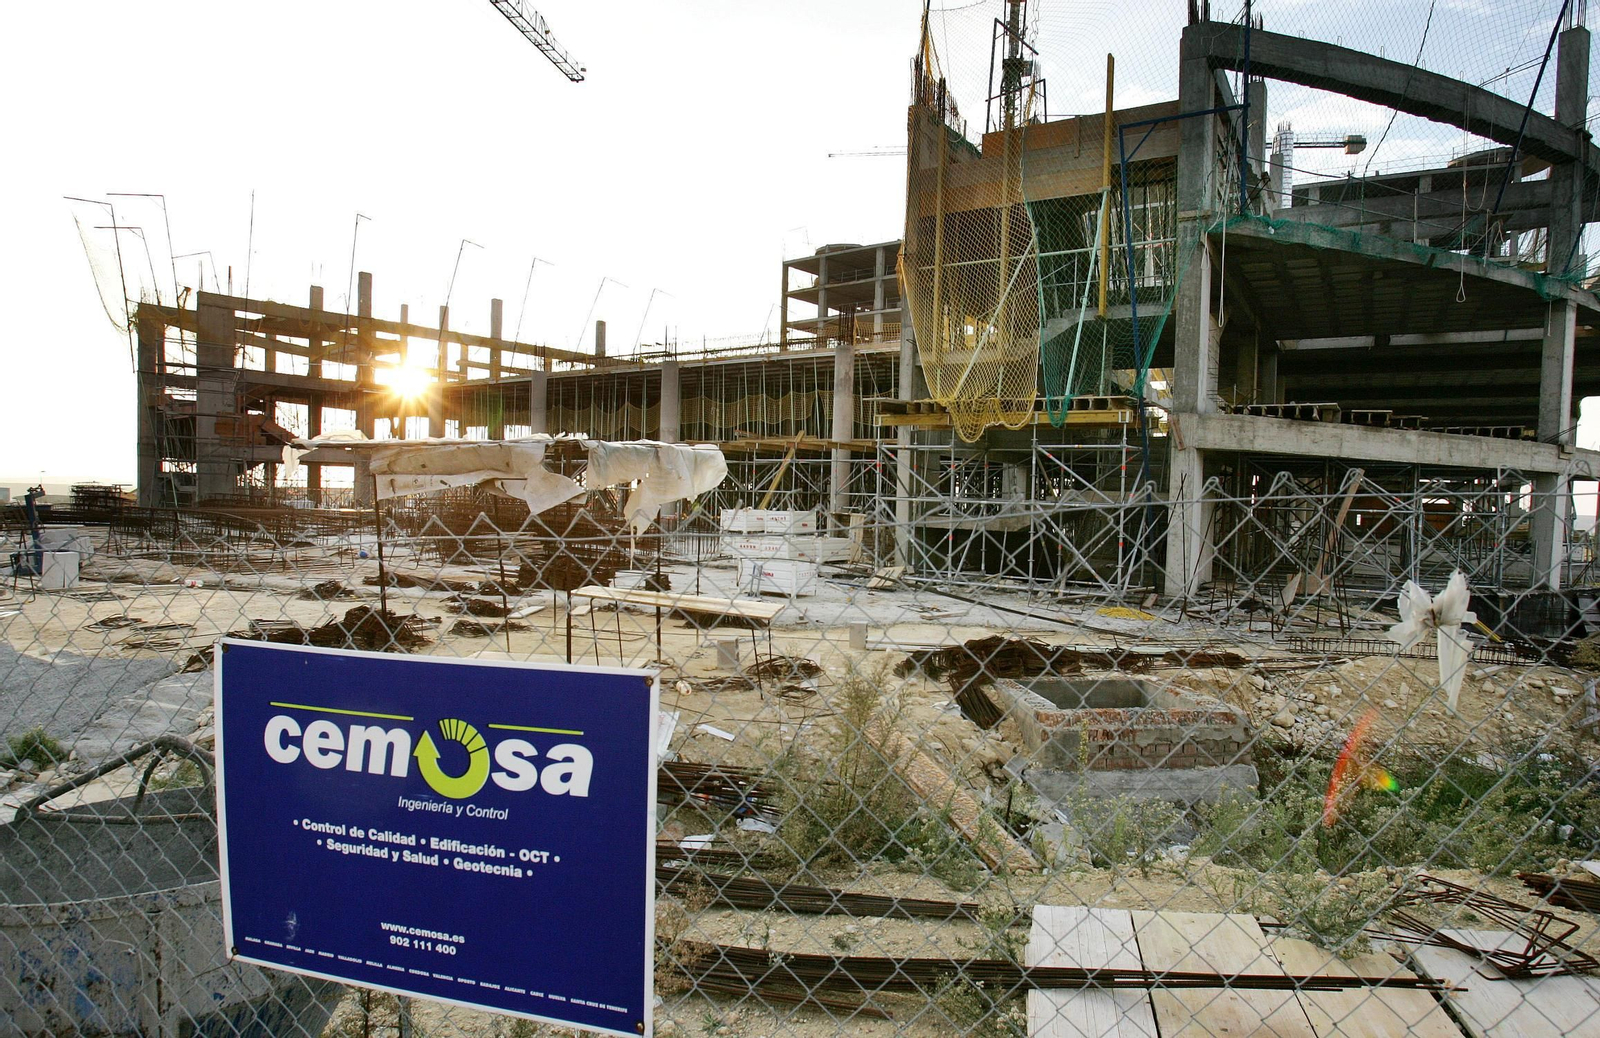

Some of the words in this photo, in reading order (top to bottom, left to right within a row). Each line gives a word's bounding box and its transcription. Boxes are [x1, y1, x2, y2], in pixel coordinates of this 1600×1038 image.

[263, 714, 594, 800] cemosa
[397, 796, 453, 814] Ingeniería
[456, 805, 464, 818] y
[466, 804, 509, 821] Control
[301, 818, 346, 836] Control
[349, 825, 365, 839] de
[367, 828, 416, 846] Calidad
[429, 836, 506, 859] Edificación
[518, 848, 550, 864] OCT
[326, 838, 389, 859] Seguridad
[391, 850, 400, 863] y
[402, 850, 439, 867] Salud
[453, 857, 523, 878] Geotecnia
[380, 921, 466, 944] www.cemosa.es
[389, 935, 411, 948] 902
[412, 940, 432, 952] 111
[435, 944, 457, 956] 400
